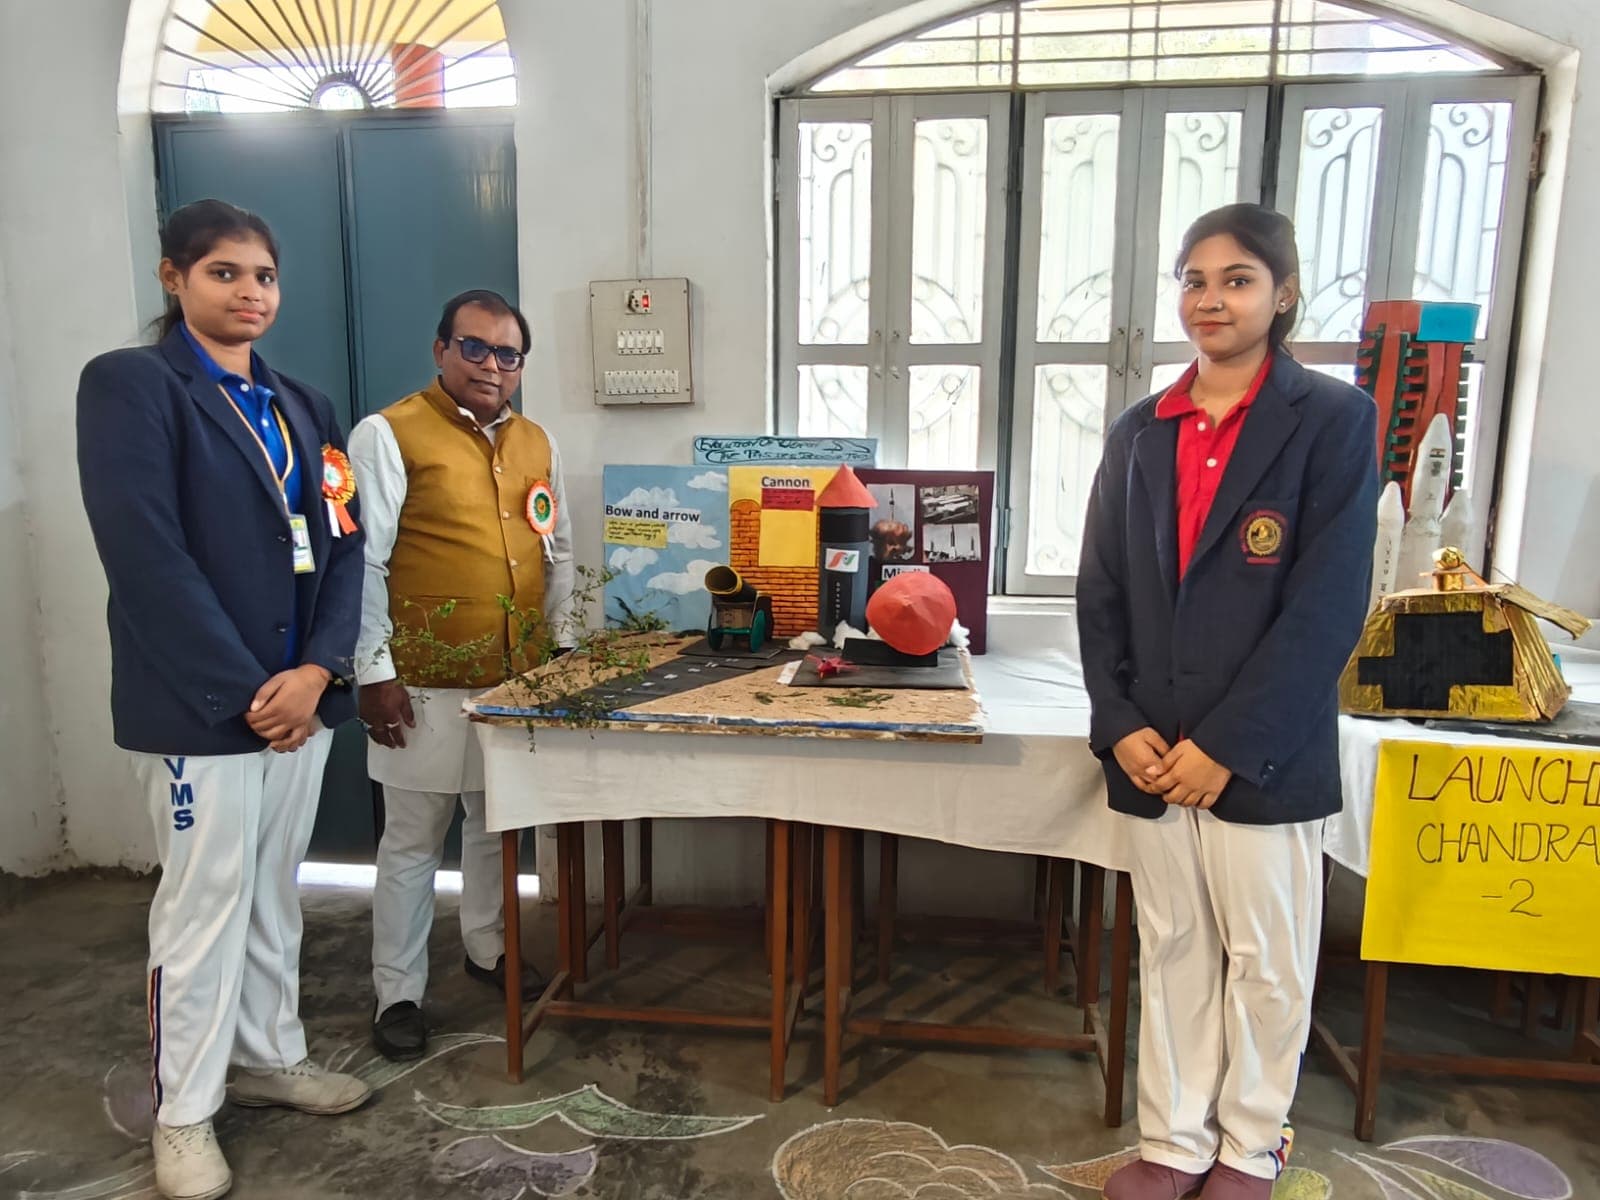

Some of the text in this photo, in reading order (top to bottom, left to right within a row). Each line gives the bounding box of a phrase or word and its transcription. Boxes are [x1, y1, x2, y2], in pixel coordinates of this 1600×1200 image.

[761, 476, 810, 488] Cannon
[605, 504, 700, 522] Bow and arrow
[163, 756, 195, 831] VMS
[1417, 822, 1600, 866] CHANDRA
